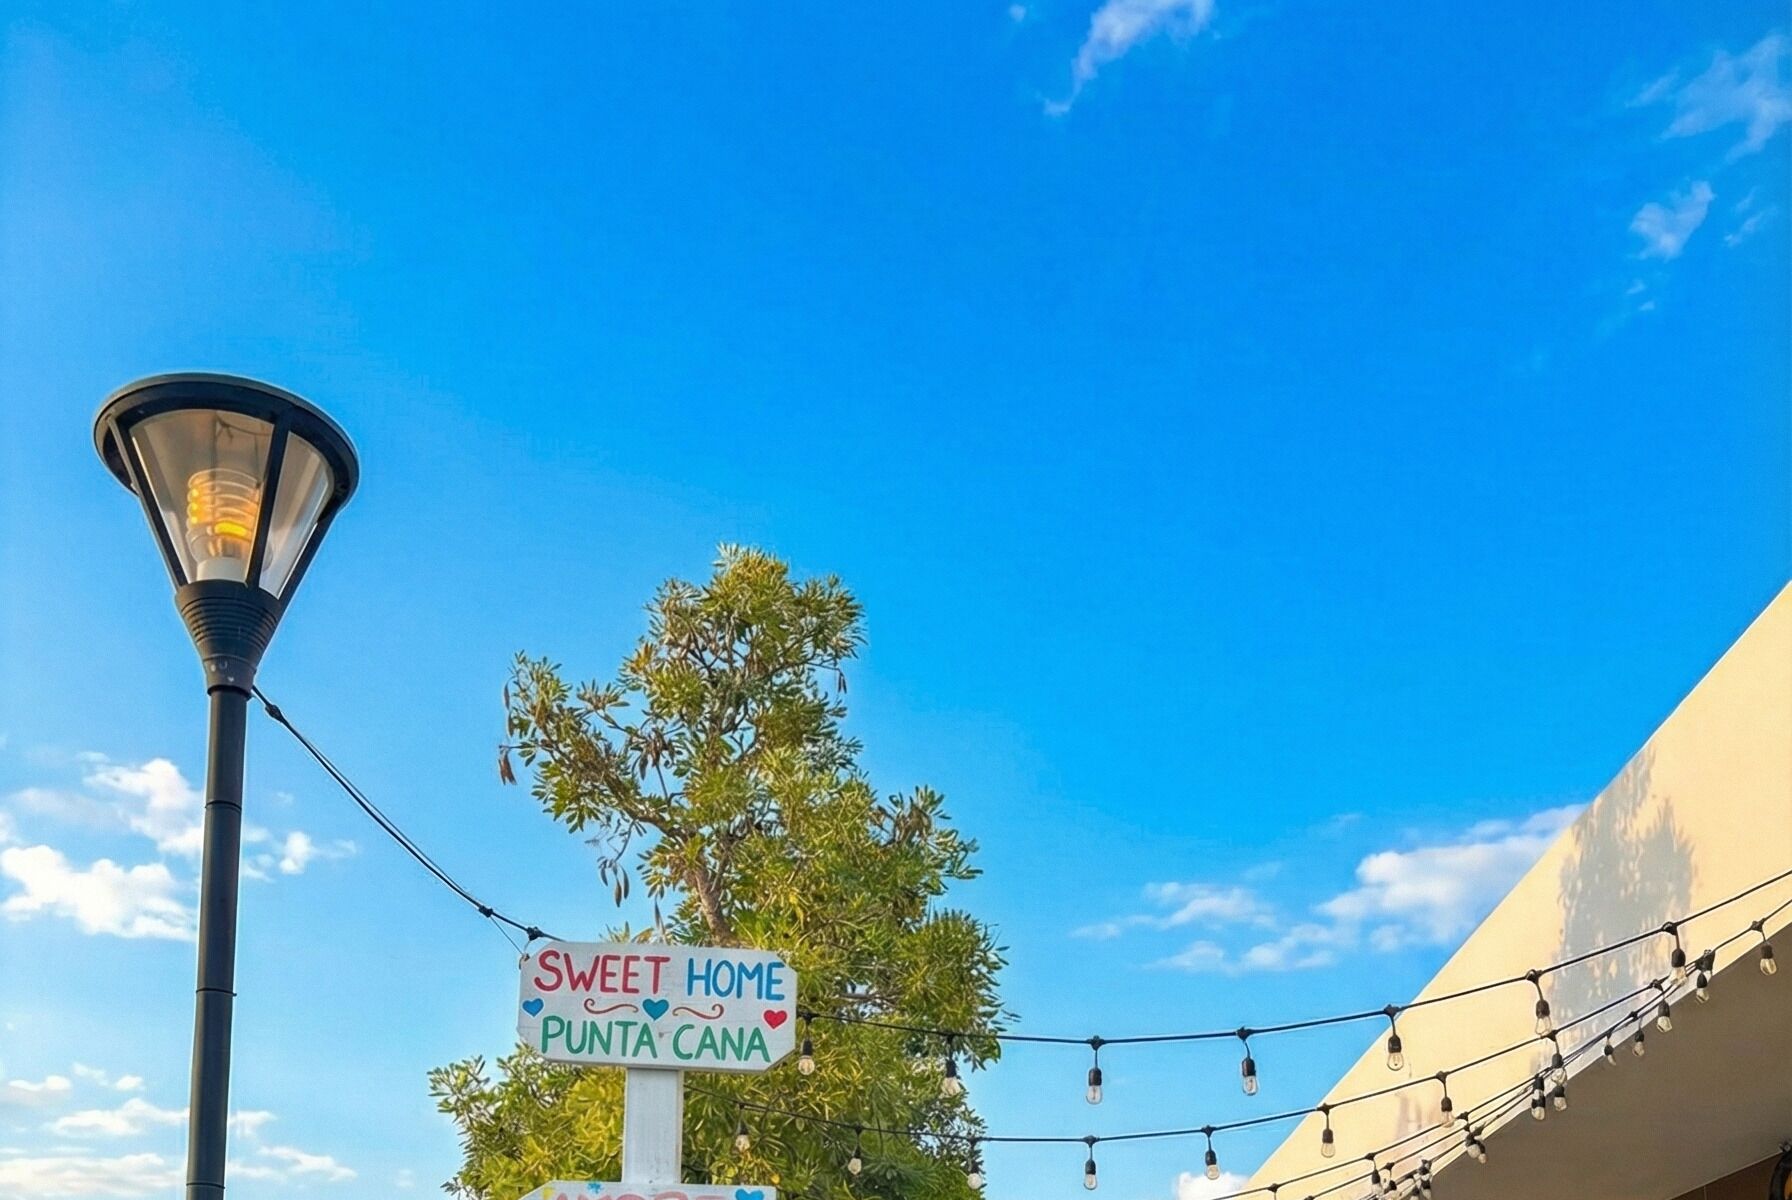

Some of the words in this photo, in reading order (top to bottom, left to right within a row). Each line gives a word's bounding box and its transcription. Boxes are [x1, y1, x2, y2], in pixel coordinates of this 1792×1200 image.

[534, 949, 671, 994] SWEET
[687, 957, 785, 1001] HOME
[540, 1015, 658, 1059] PUNTA
[672, 1023, 771, 1063] CANA
